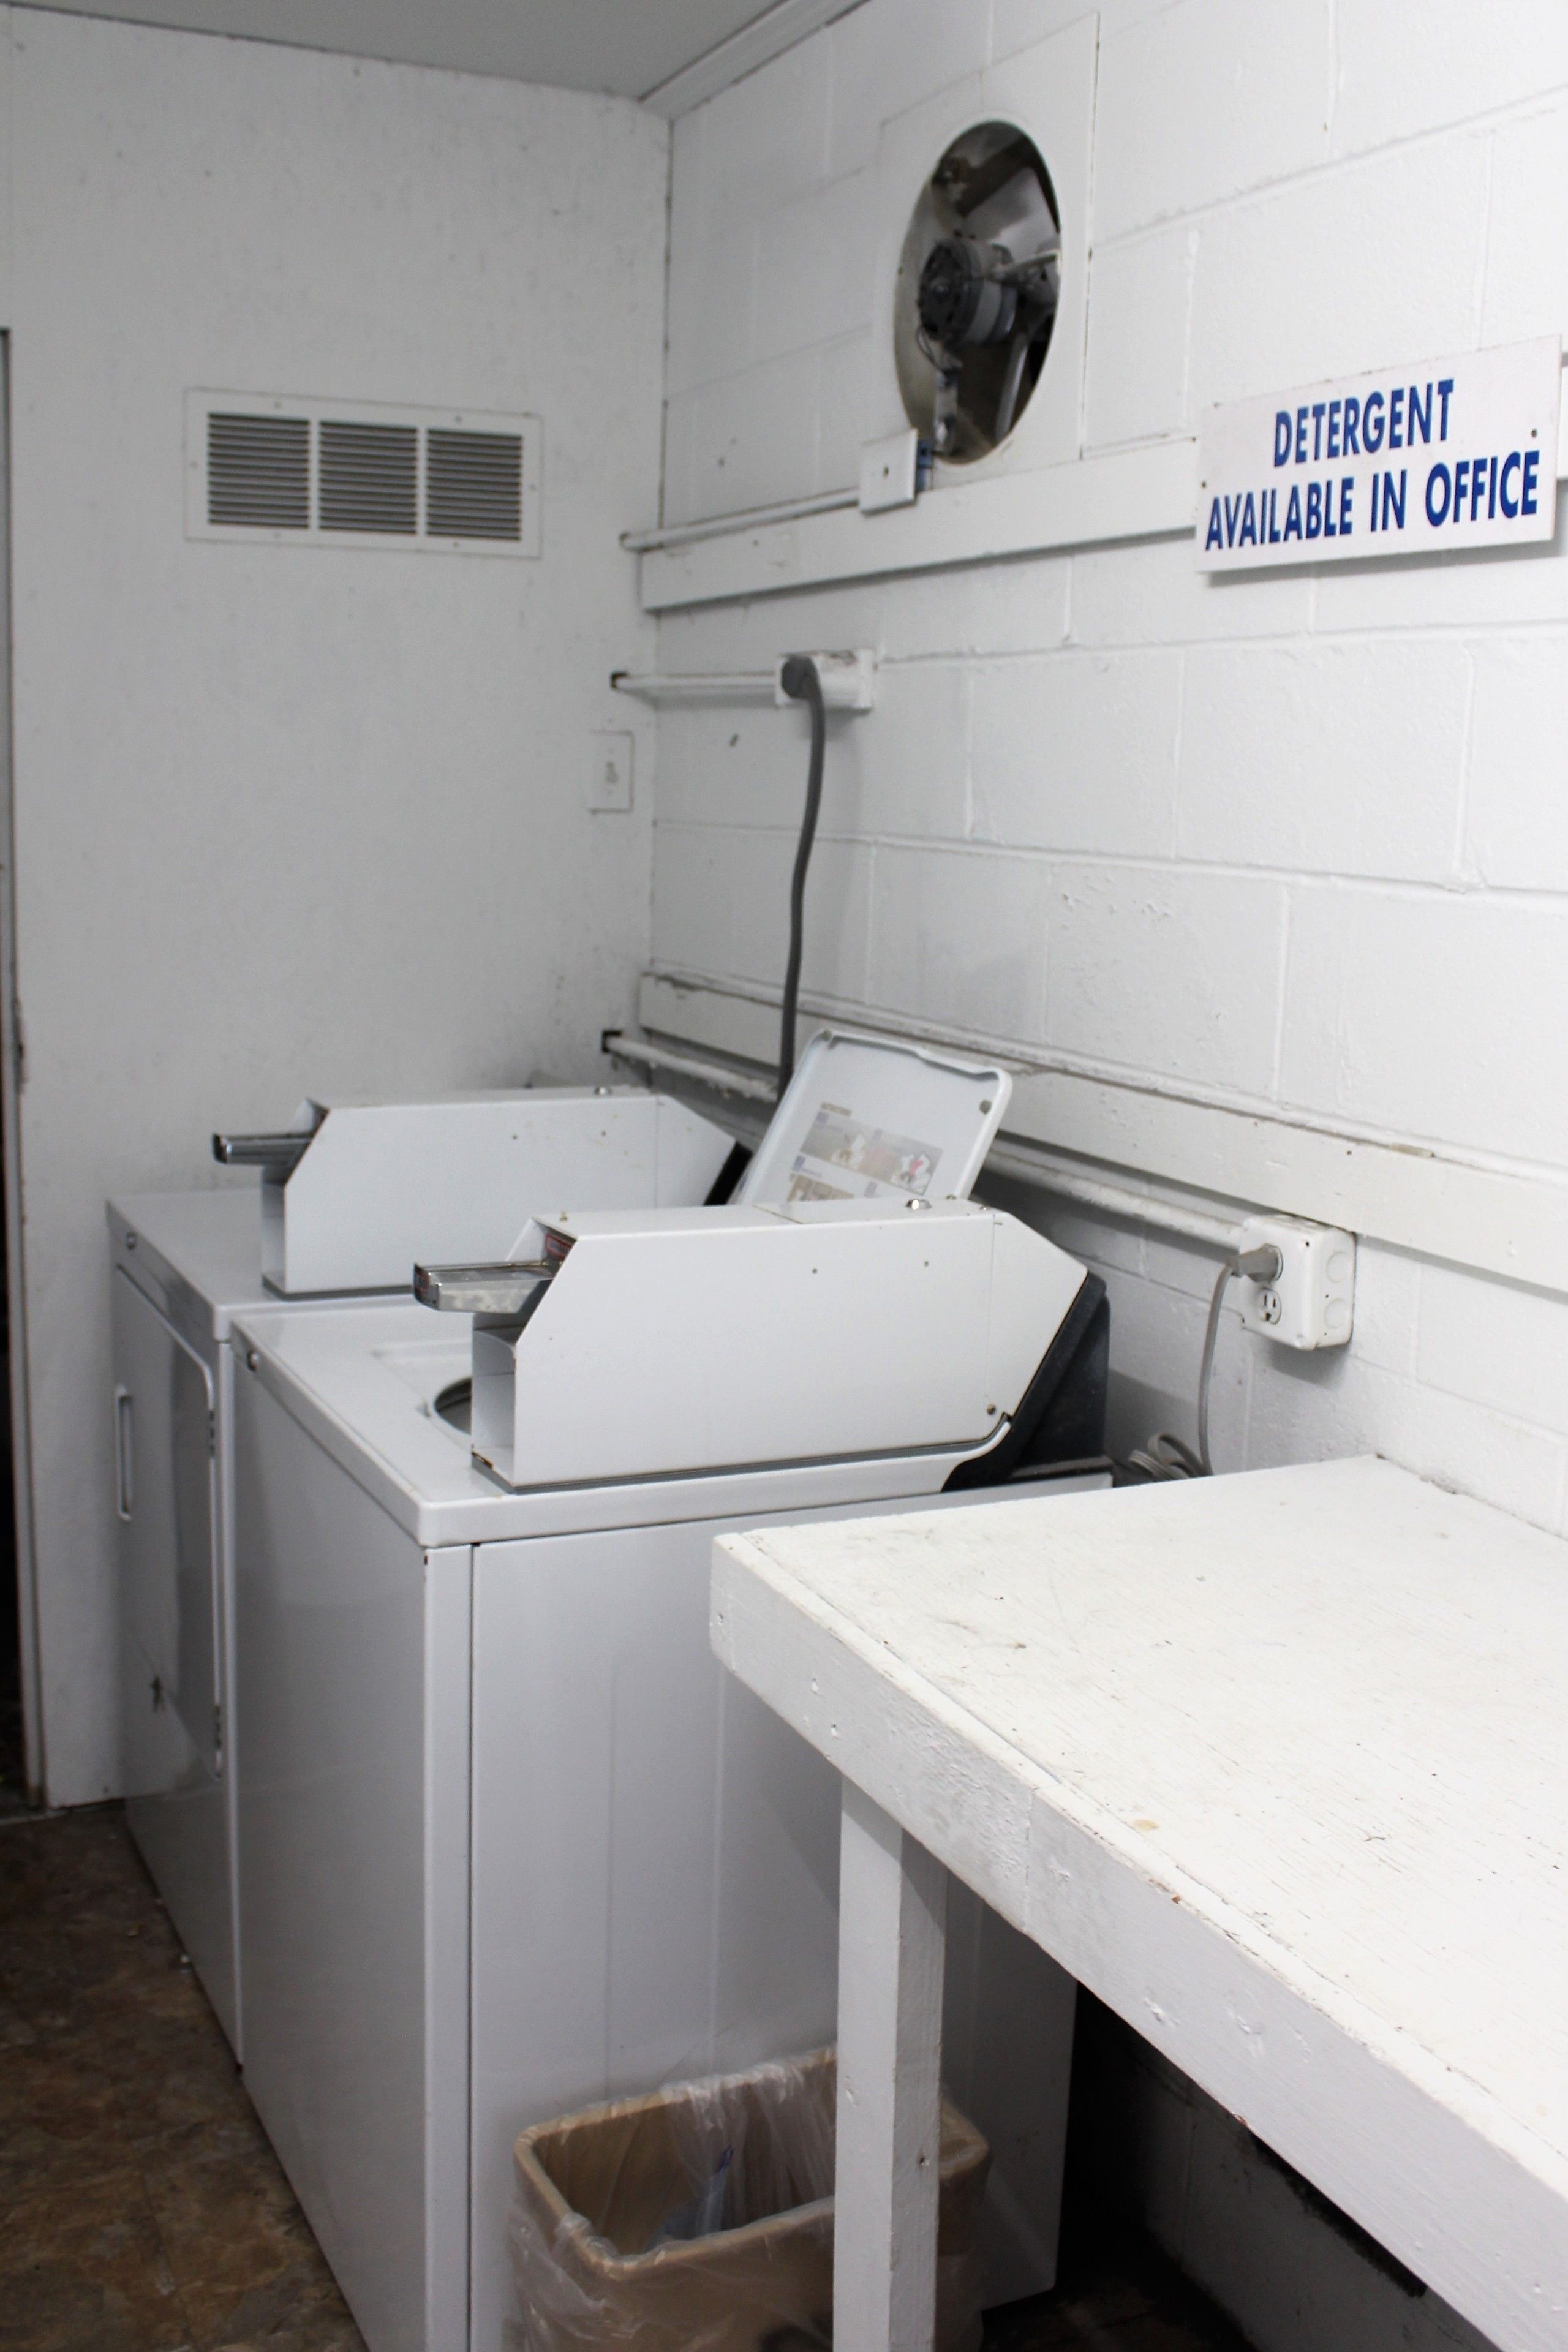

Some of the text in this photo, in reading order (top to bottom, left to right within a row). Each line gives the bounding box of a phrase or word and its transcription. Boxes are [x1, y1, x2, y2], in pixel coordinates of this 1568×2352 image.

[1274, 378, 1455, 467] DETERGENT
[1205, 450, 1540, 551] AVAILABLE IN OFFICE
